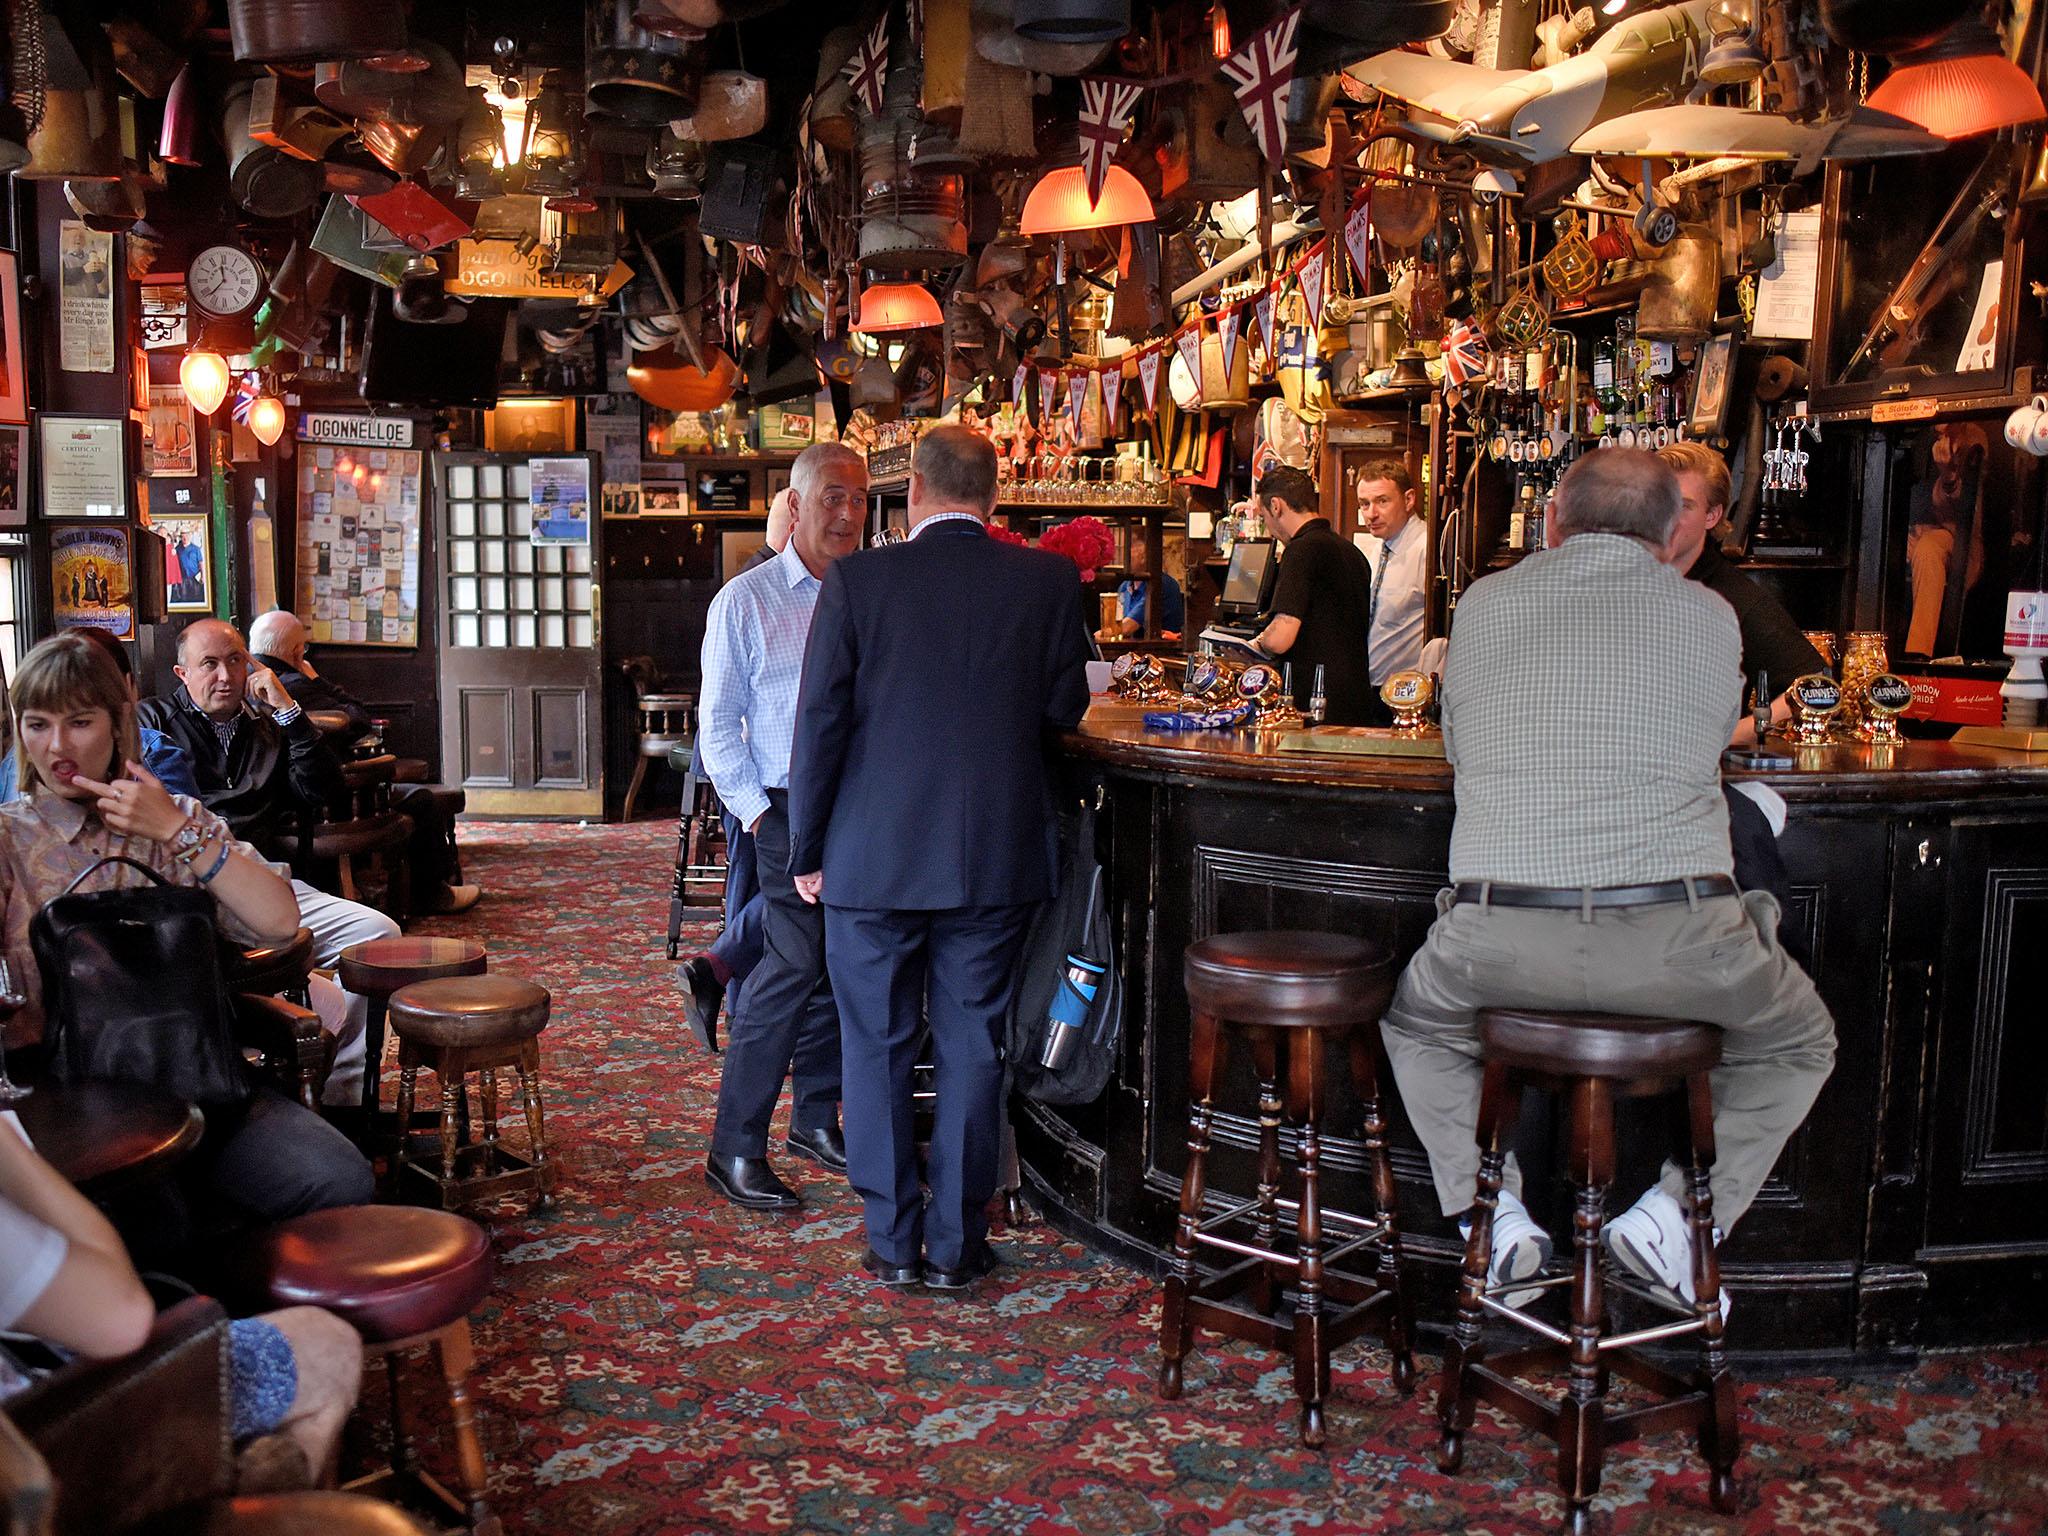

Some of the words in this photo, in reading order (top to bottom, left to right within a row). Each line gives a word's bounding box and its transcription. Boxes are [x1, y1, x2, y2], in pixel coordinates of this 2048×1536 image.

[460, 270, 592, 290] OGONNELLO
[67, 300, 85, 308] drink
[87, 300, 109, 310] whisky
[313, 419, 404, 441] OGONNELLOE
[1395, 680, 1417, 688] HONEY
[1910, 684, 1940, 697] ONDON
[1395, 687, 1417, 697] DEW
[1800, 686, 1840, 700] GUINNESS
[1872, 685, 1911, 699] GUINNESS
[1912, 695, 1935, 704] PRIDE
